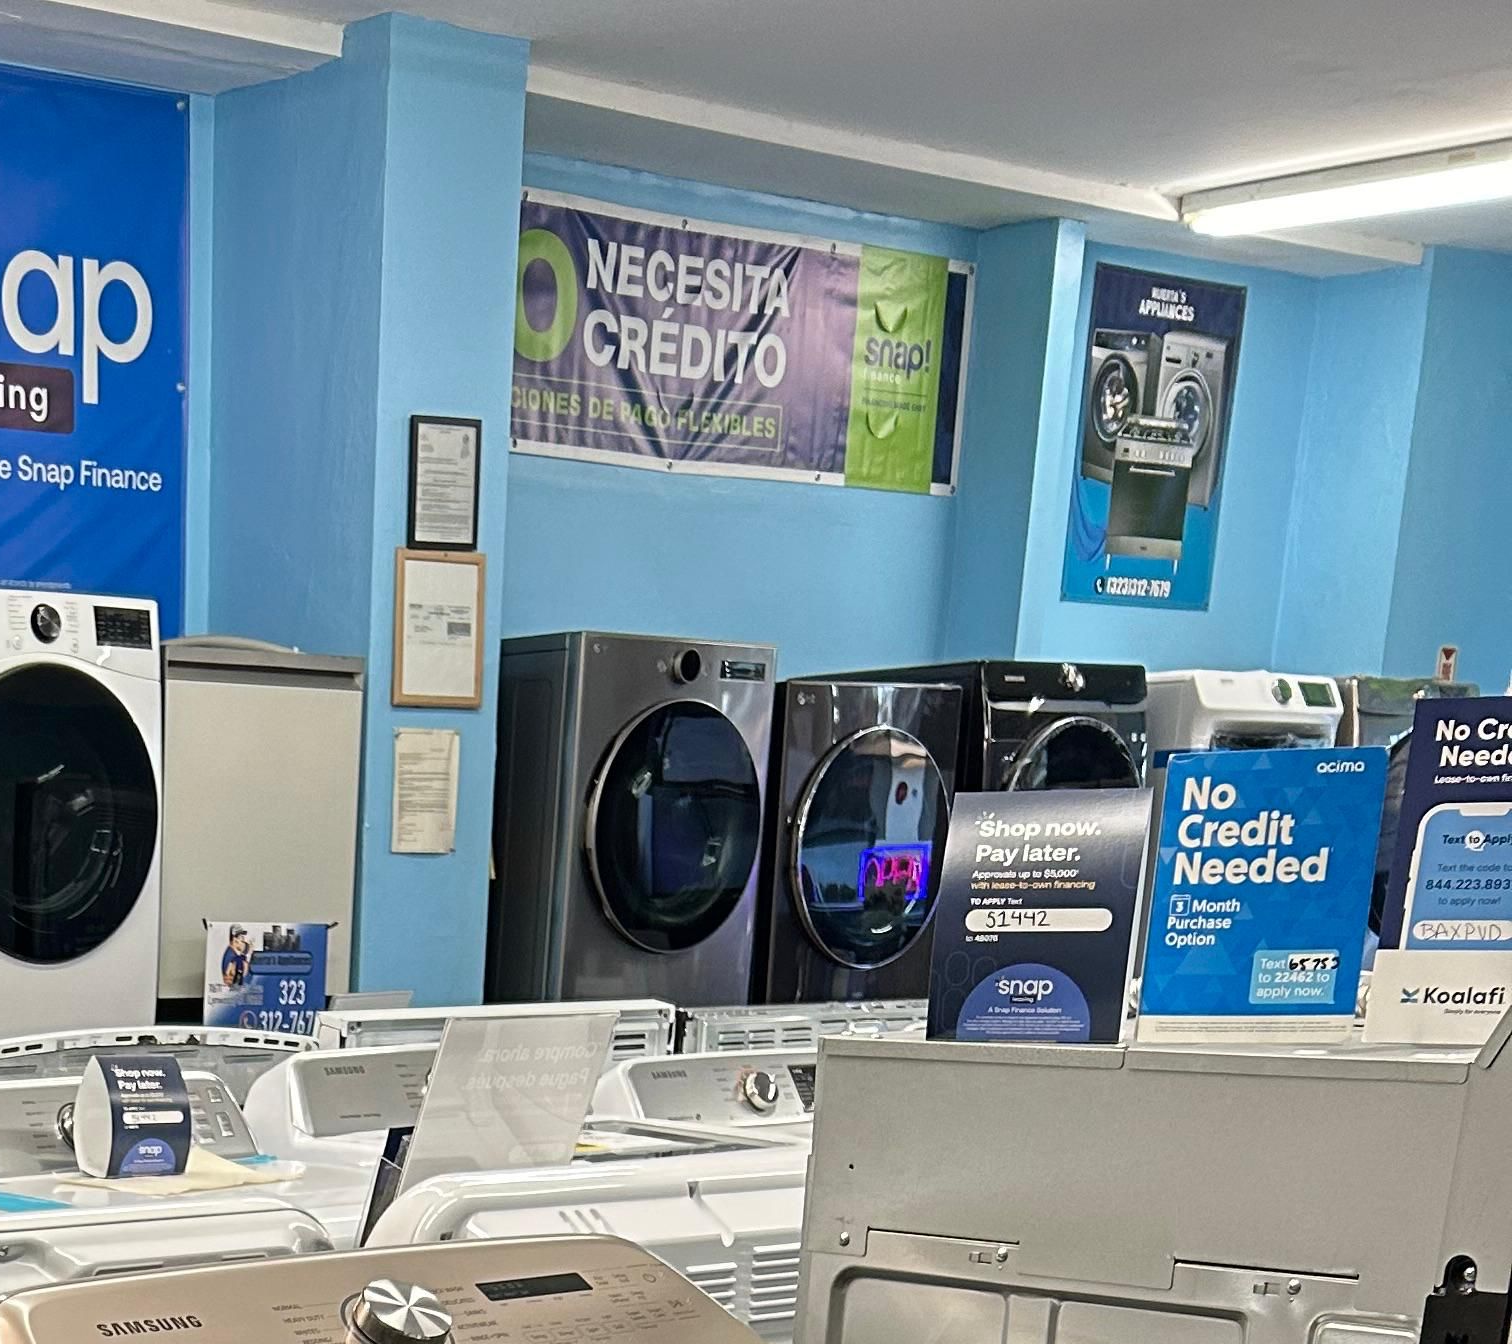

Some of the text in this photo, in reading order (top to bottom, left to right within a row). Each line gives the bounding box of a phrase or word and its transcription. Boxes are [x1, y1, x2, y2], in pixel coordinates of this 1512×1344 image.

[587, 239, 790, 317] NECESITA
[515, 228, 578, 363] O
[583, 307, 787, 388] CRÉDITO
[864, 337, 931, 380] snap!
[512, 386, 777, 439] CIONES DE PAGO FLEXIBLES
[18, 456, 74, 490] Snap
[80, 460, 162, 491] Finance
[1436, 718, 1512, 741] No Cr
[1317, 760, 1365, 773] acima
[1182, 776, 1236, 810] No
[979, 820, 1101, 841] Shop now.
[1178, 810, 1295, 848] Credit
[1443, 834, 1466, 844] Text
[1469, 835, 1480, 844] to
[975, 844, 1081, 866] Pay later.
[972, 870, 1041, 880] Approvals up to
[1172, 847, 1331, 885] Needed
[1437, 863, 1496, 872] Text the code
[1054, 881, 1095, 890] financing
[1175, 899, 1241, 913] 3 Month
[1167, 916, 1232, 930] Purchase
[1165, 932, 1215, 948] Option
[1260, 958, 1286, 969] Text
[1258, 972, 1330, 983] to 22462 to
[279, 980, 306, 1005] 323
[998, 979, 1053, 1000] snap
[1256, 985, 1324, 999] apply now.
[1423, 986, 1505, 1004] Koalafi
[259, 1010, 315, 1034] 312-767
[114, 1069, 166, 1079] Shop now.
[117, 1080, 163, 1091] Pay later.
[138, 1145, 162, 1156] snap
[96, 1315, 203, 1337] SAMSUNG
